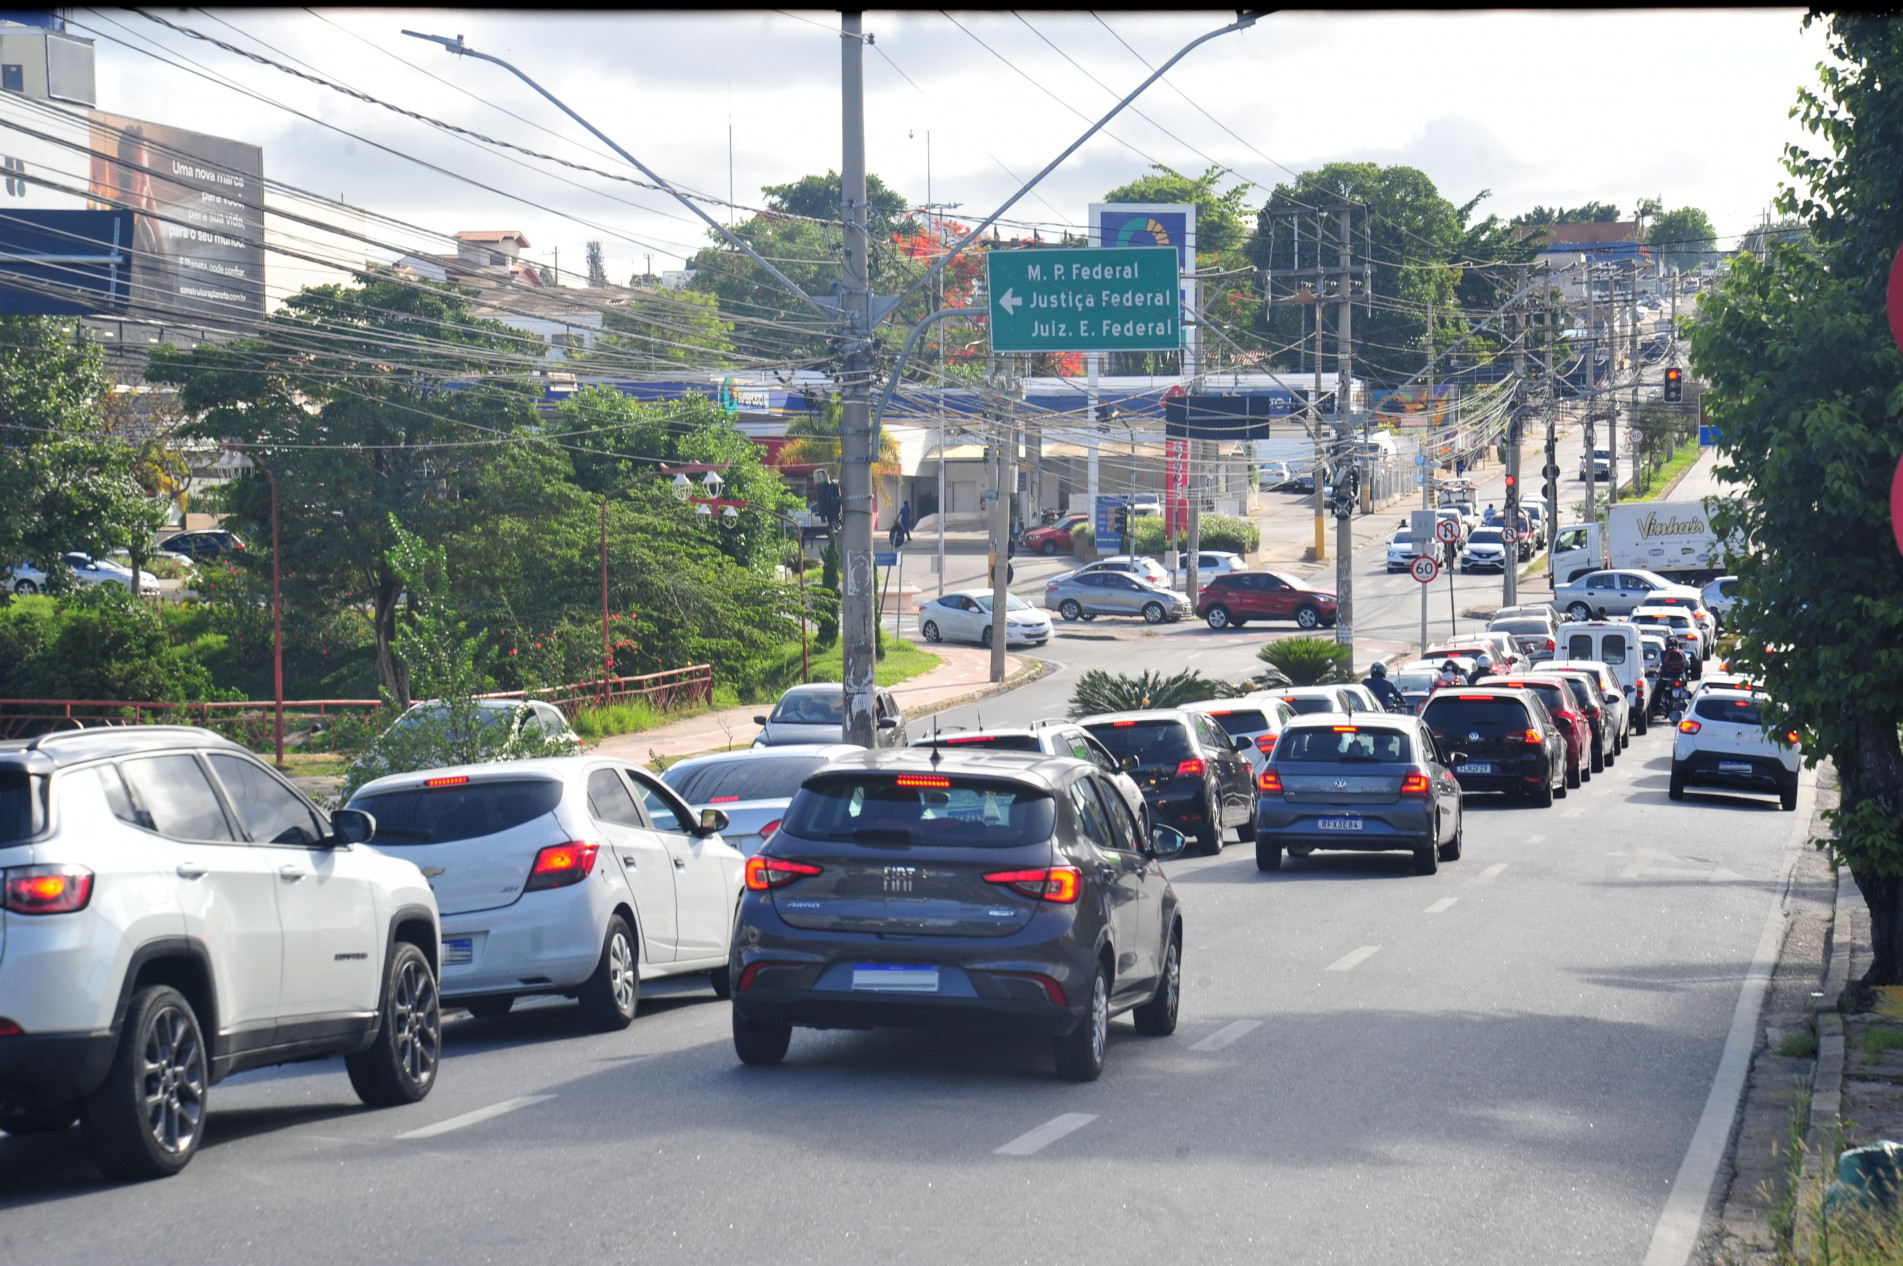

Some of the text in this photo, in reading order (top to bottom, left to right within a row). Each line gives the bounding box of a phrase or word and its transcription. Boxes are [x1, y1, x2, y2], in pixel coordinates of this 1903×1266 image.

[172, 160, 244, 187] Uma nova marca
[169, 226, 188, 239] para
[190, 230, 196, 239] o
[197, 232, 213, 242] seu
[1027, 262, 1139, 280] M. P. Federal
[1030, 289, 1170, 311] Justiça Federal
[1031, 319, 1171, 337] Juiz. E. Federal
[1637, 511, 1705, 540] Vinhais
[1416, 562, 1433, 575] 60
